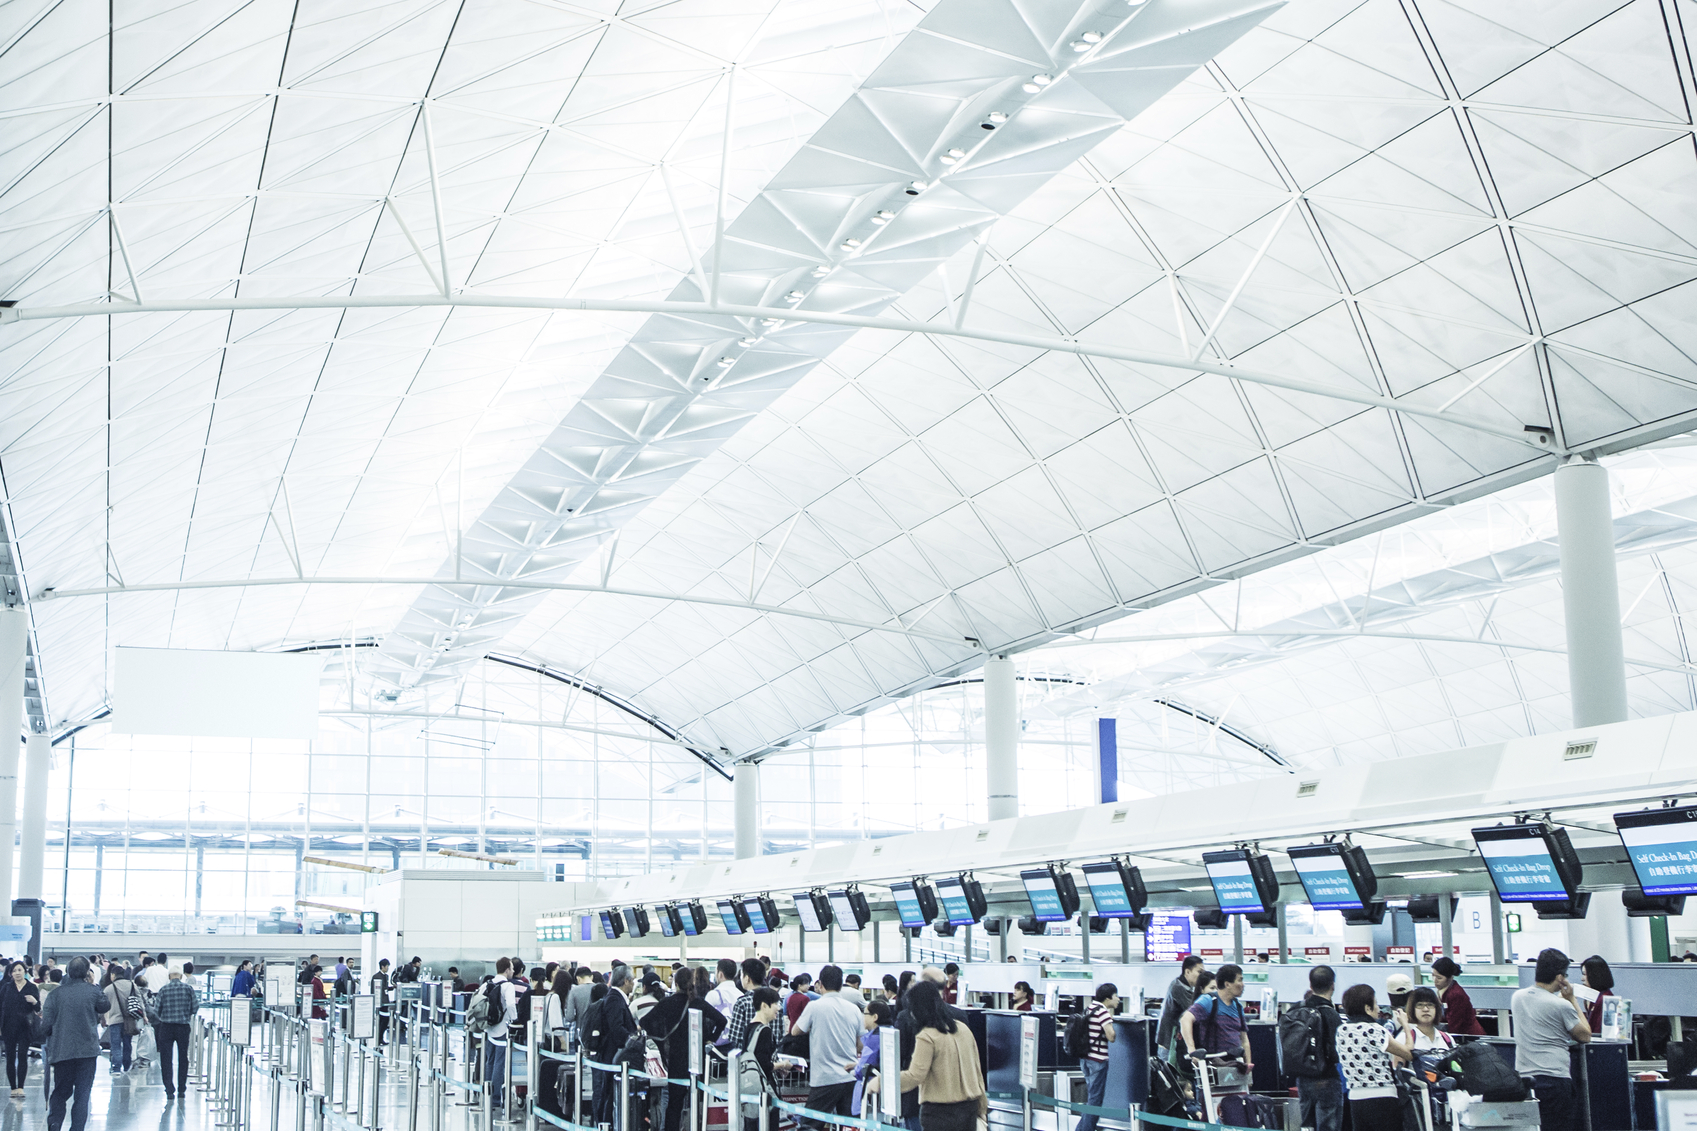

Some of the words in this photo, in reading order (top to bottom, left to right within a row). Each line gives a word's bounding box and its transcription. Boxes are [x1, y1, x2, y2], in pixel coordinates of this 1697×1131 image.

[1636, 854, 1649, 864] Self
[1676, 851, 1692, 862] Bag
[1492, 864, 1504, 873] Self
[1525, 863, 1538, 873] Bag
[1535, 862, 1551, 872] Drop
[1472, 911, 1481, 930] B
